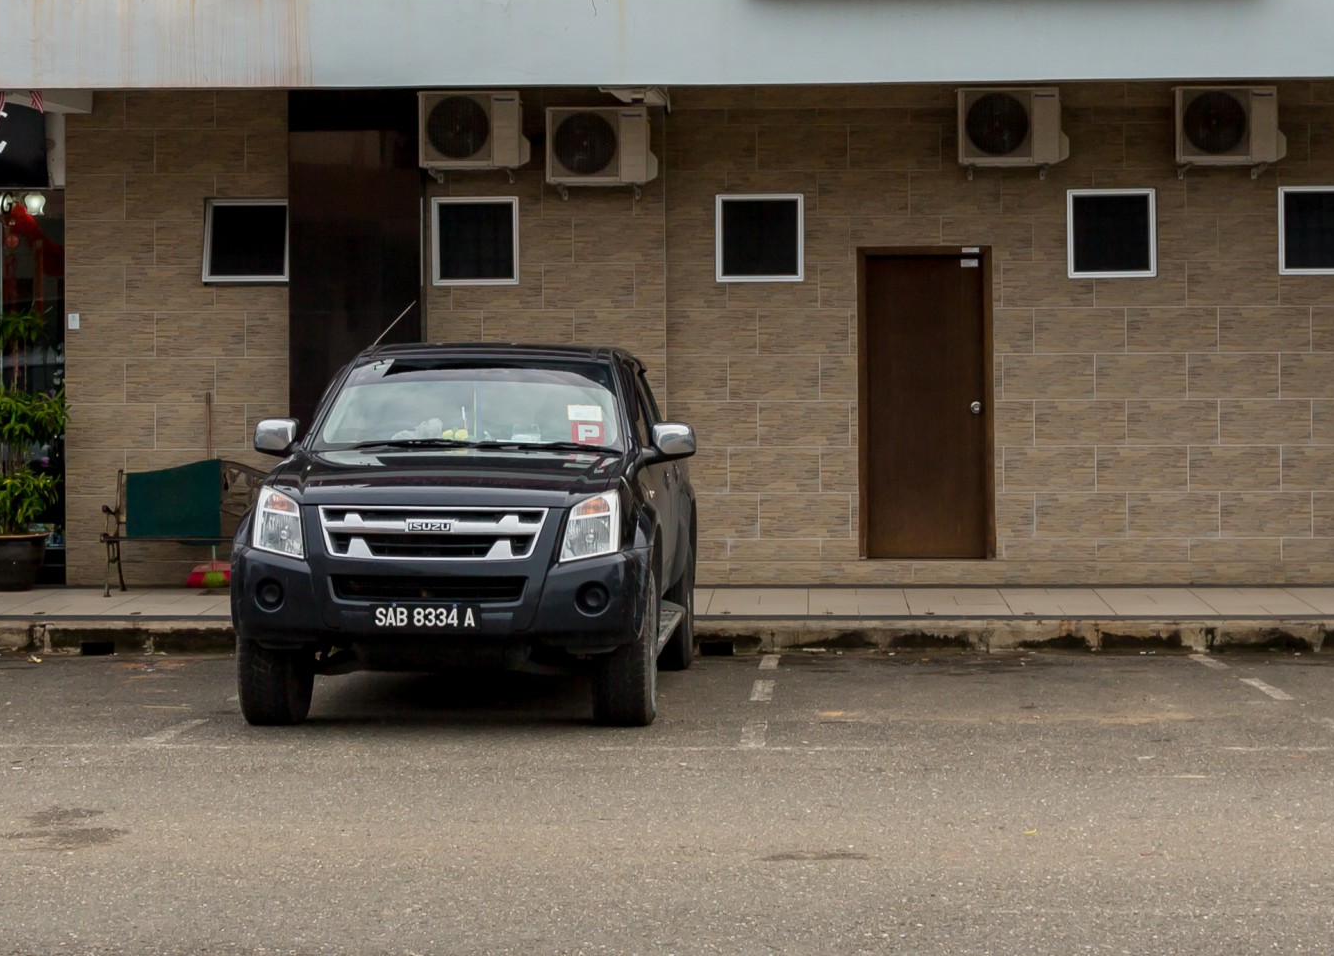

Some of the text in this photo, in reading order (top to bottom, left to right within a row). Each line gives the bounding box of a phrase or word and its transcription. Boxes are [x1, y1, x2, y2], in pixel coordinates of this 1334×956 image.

[578, 425, 600, 441] P
[408, 522, 451, 531] ISUZU
[375, 607, 475, 627] SAB 8334 A
